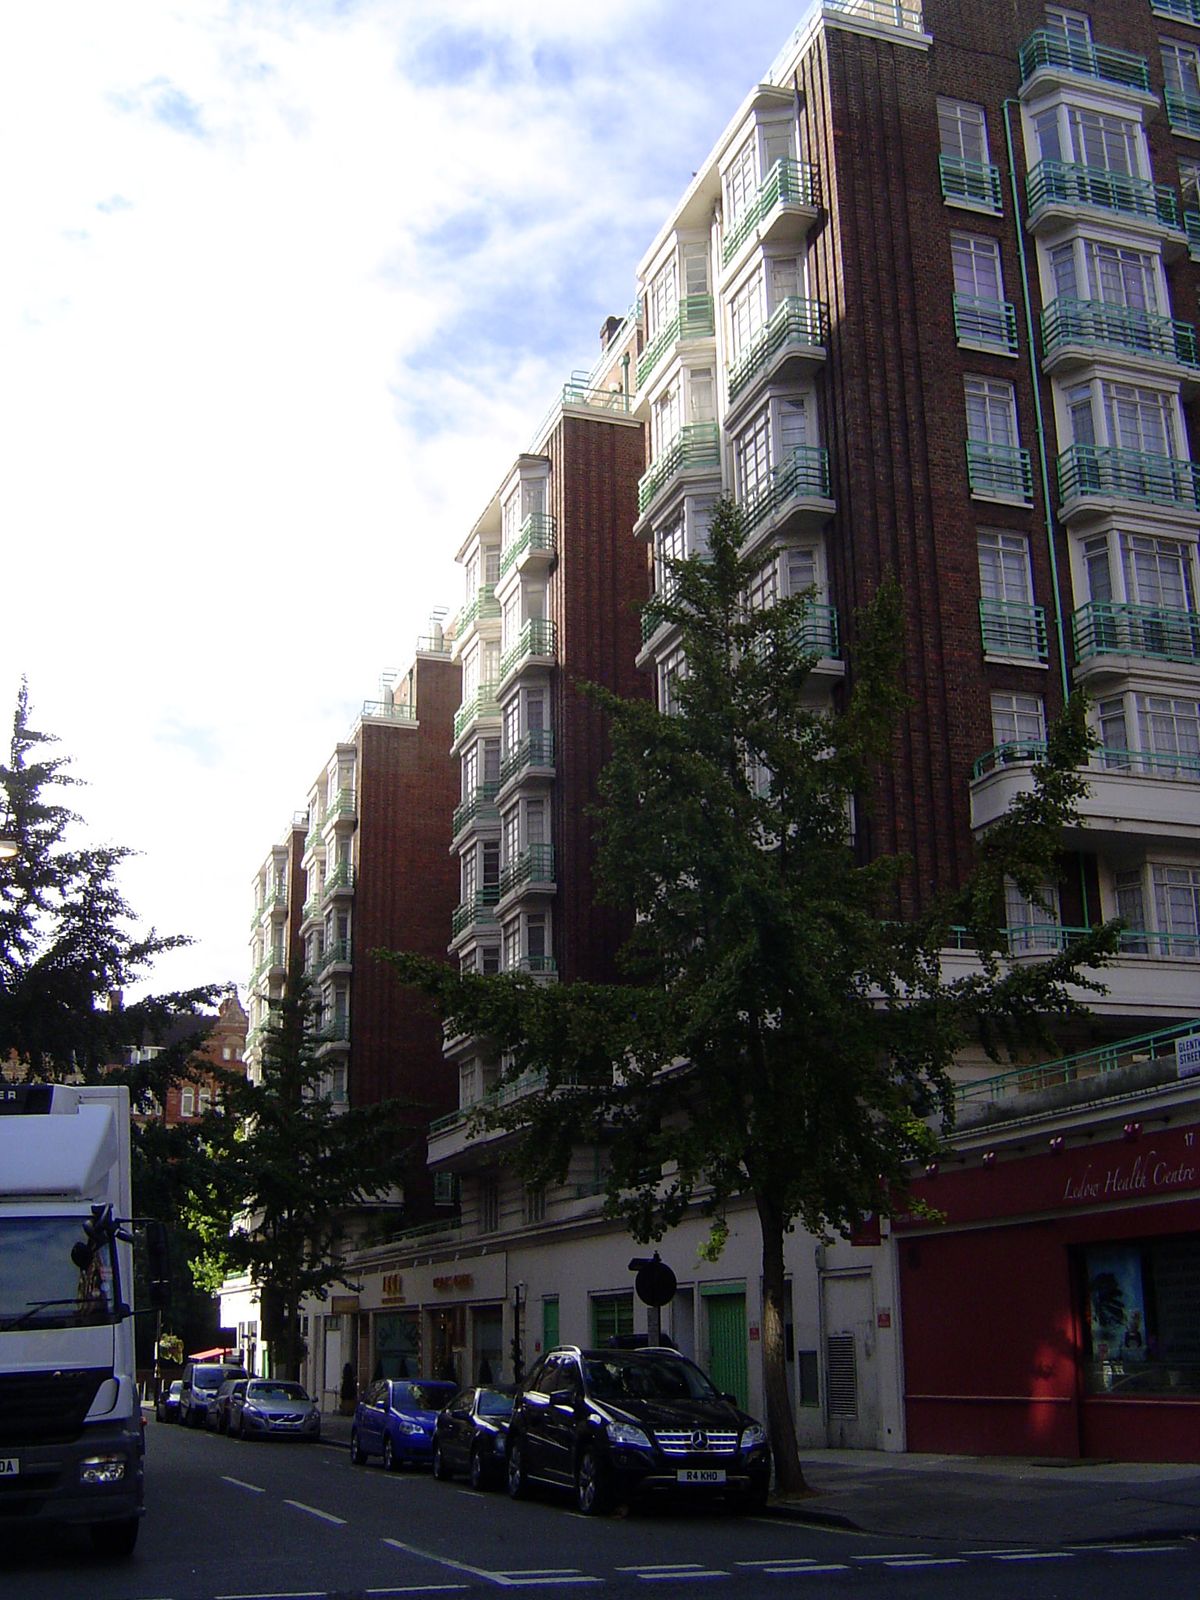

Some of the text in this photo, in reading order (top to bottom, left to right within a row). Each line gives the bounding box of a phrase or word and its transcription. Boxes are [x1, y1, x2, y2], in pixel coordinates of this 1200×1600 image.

[1178, 1038, 1200, 1053] GLENT
[1184, 1132, 1195, 1147] 17
[1105, 1151, 1156, 1192] Health
[1153, 1161, 1194, 1185] Centre
[686, 1471, 698, 1481] R4
